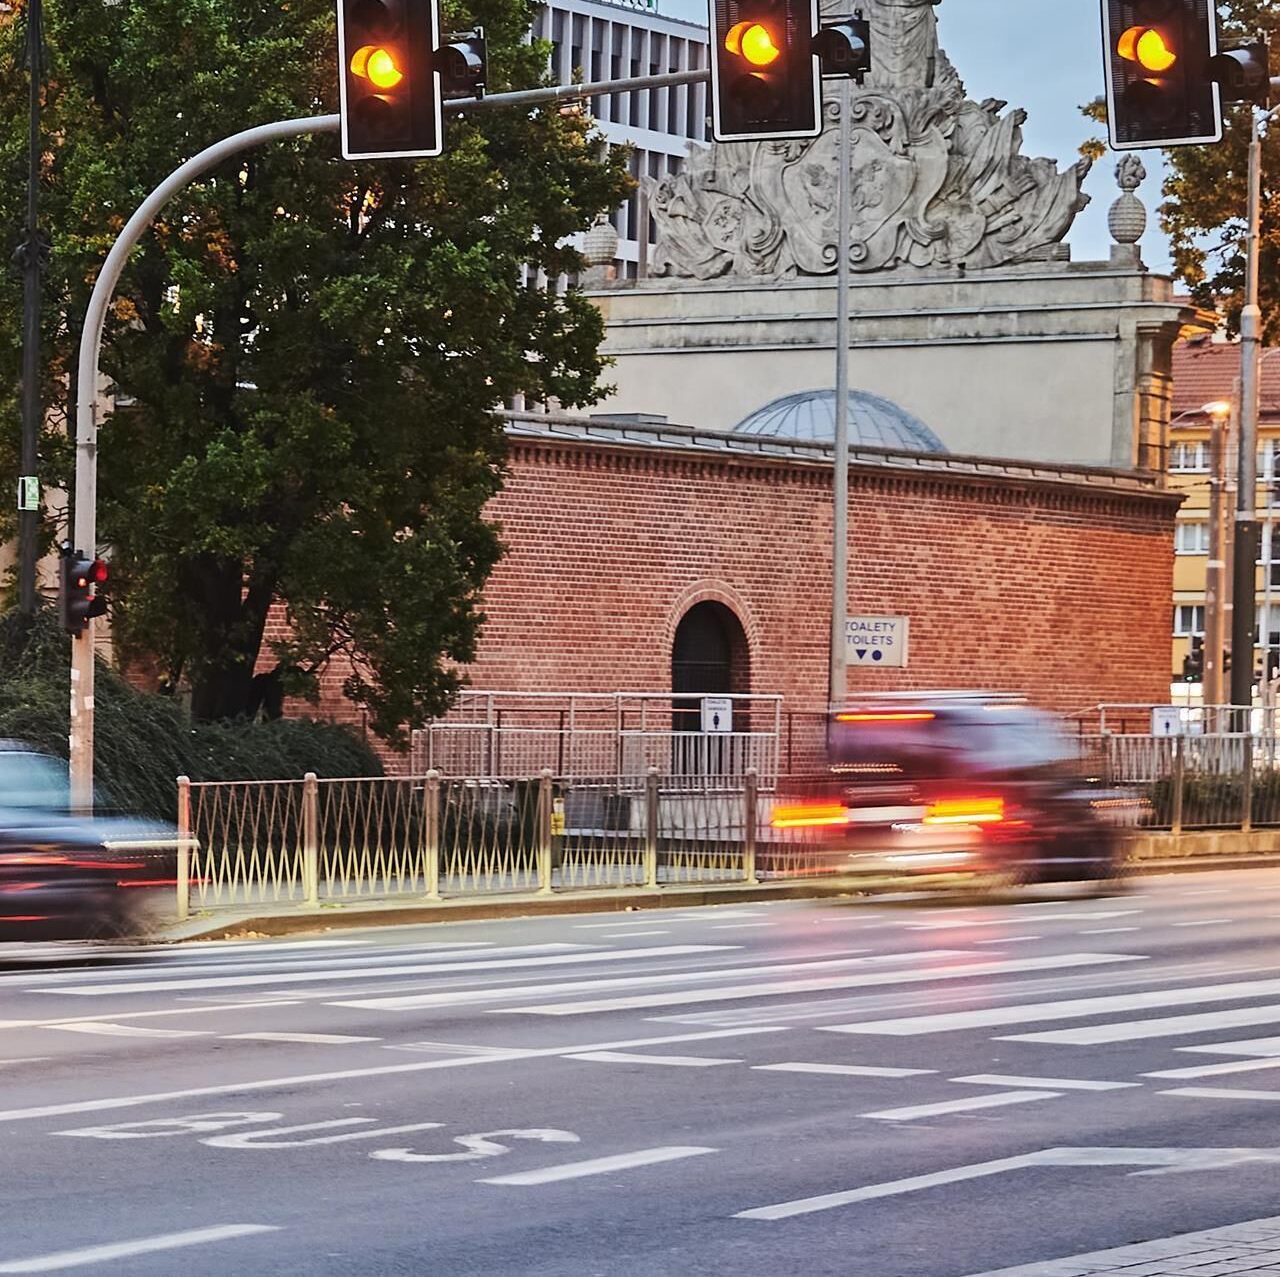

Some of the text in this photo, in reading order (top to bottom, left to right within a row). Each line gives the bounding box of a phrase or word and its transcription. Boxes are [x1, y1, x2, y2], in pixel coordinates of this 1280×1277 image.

[844, 621, 896, 632] TOALETY
[845, 634, 894, 645] TOILETS
[47, 1110, 581, 1162] BUS
